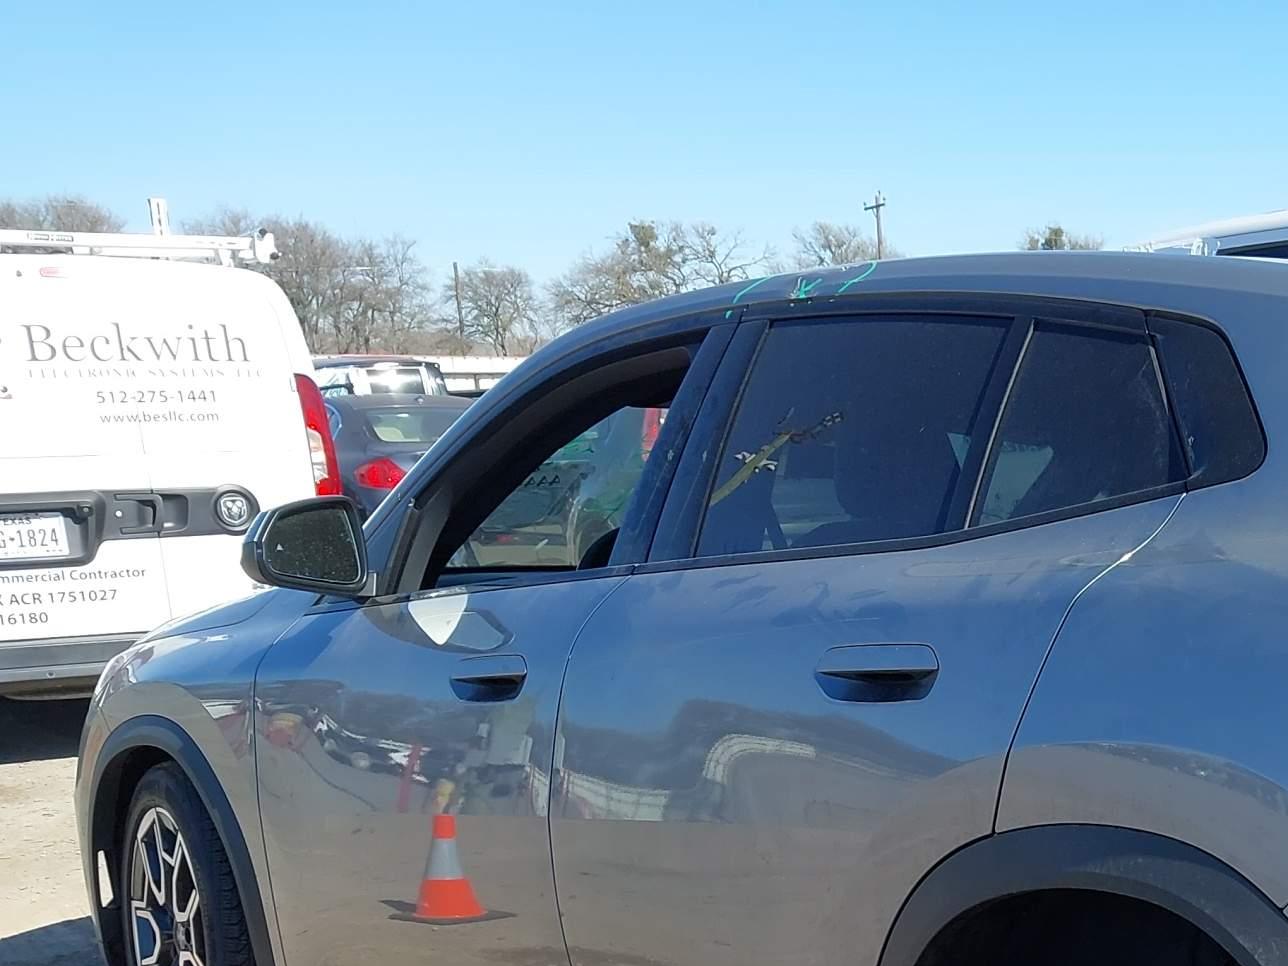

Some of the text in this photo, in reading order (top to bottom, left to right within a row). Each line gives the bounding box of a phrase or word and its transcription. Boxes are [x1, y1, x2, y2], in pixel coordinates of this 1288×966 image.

[20, 322, 250, 362] Beckwith
[96, 390, 217, 404] 512-275-1441
[99, 411, 220, 424] www.besllc.com
[69, 568, 146, 580] Contractor
[9, 592, 42, 605] ACR
[48, 589, 117, 603] 1751027
